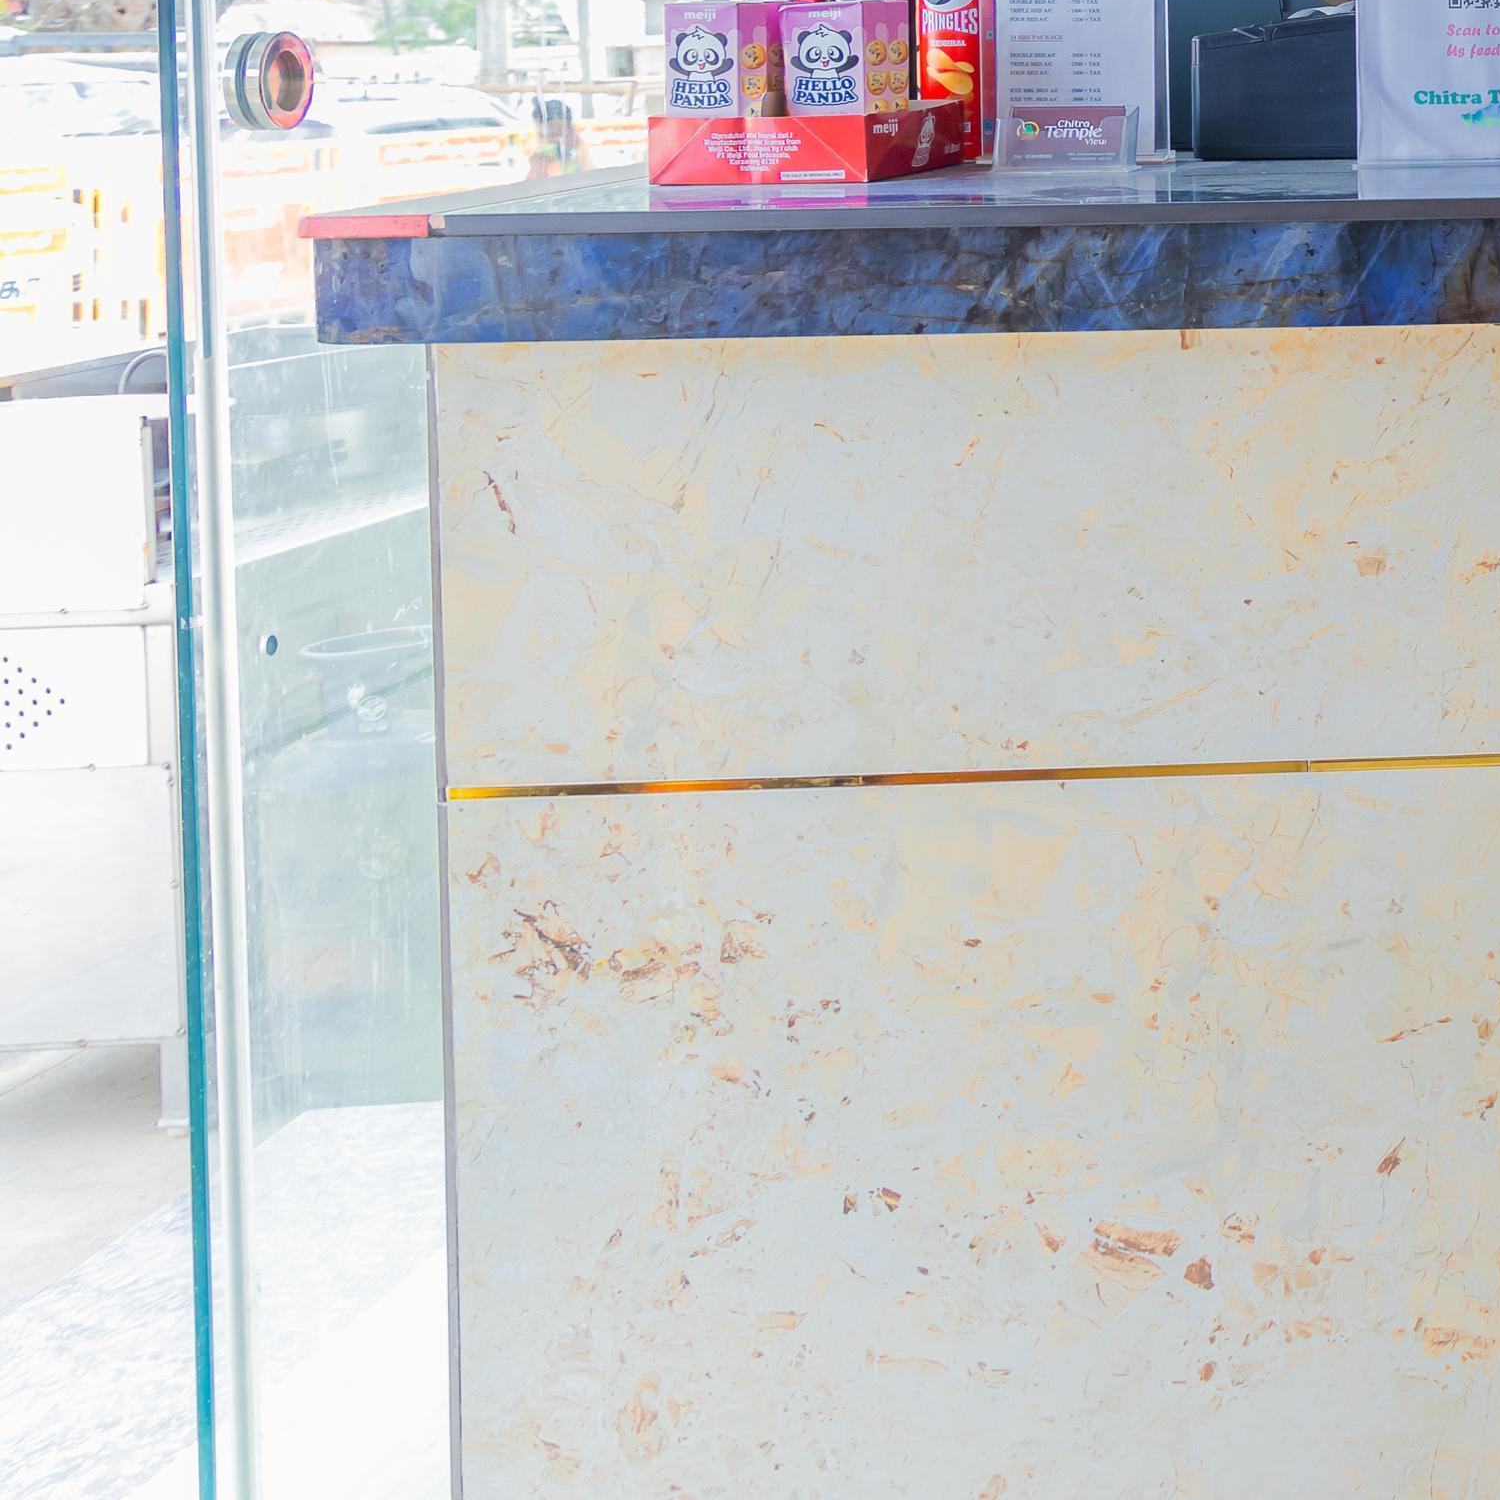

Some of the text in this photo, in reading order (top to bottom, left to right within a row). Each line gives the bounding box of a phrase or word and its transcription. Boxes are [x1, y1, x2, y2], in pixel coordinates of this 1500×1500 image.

[684, 9, 717, 21] meiji
[808, 8, 842, 20] meiji
[922, 8, 979, 35] PRINGLES
[1446, 23, 1481, 37] Scan
[1485, 23, 1500, 36] to
[931, 39, 966, 47] ORIGINAL
[674, 81, 728, 95] HELLO
[797, 78, 854, 92] HELLO
[671, 94, 731, 108] PANDA
[795, 91, 857, 104] PANDA
[1413, 89, 1482, 105] Chitra
[873, 119, 898, 136] meiji
[1058, 119, 1090, 128] Chitra
[1045, 125, 1103, 140] Temple
